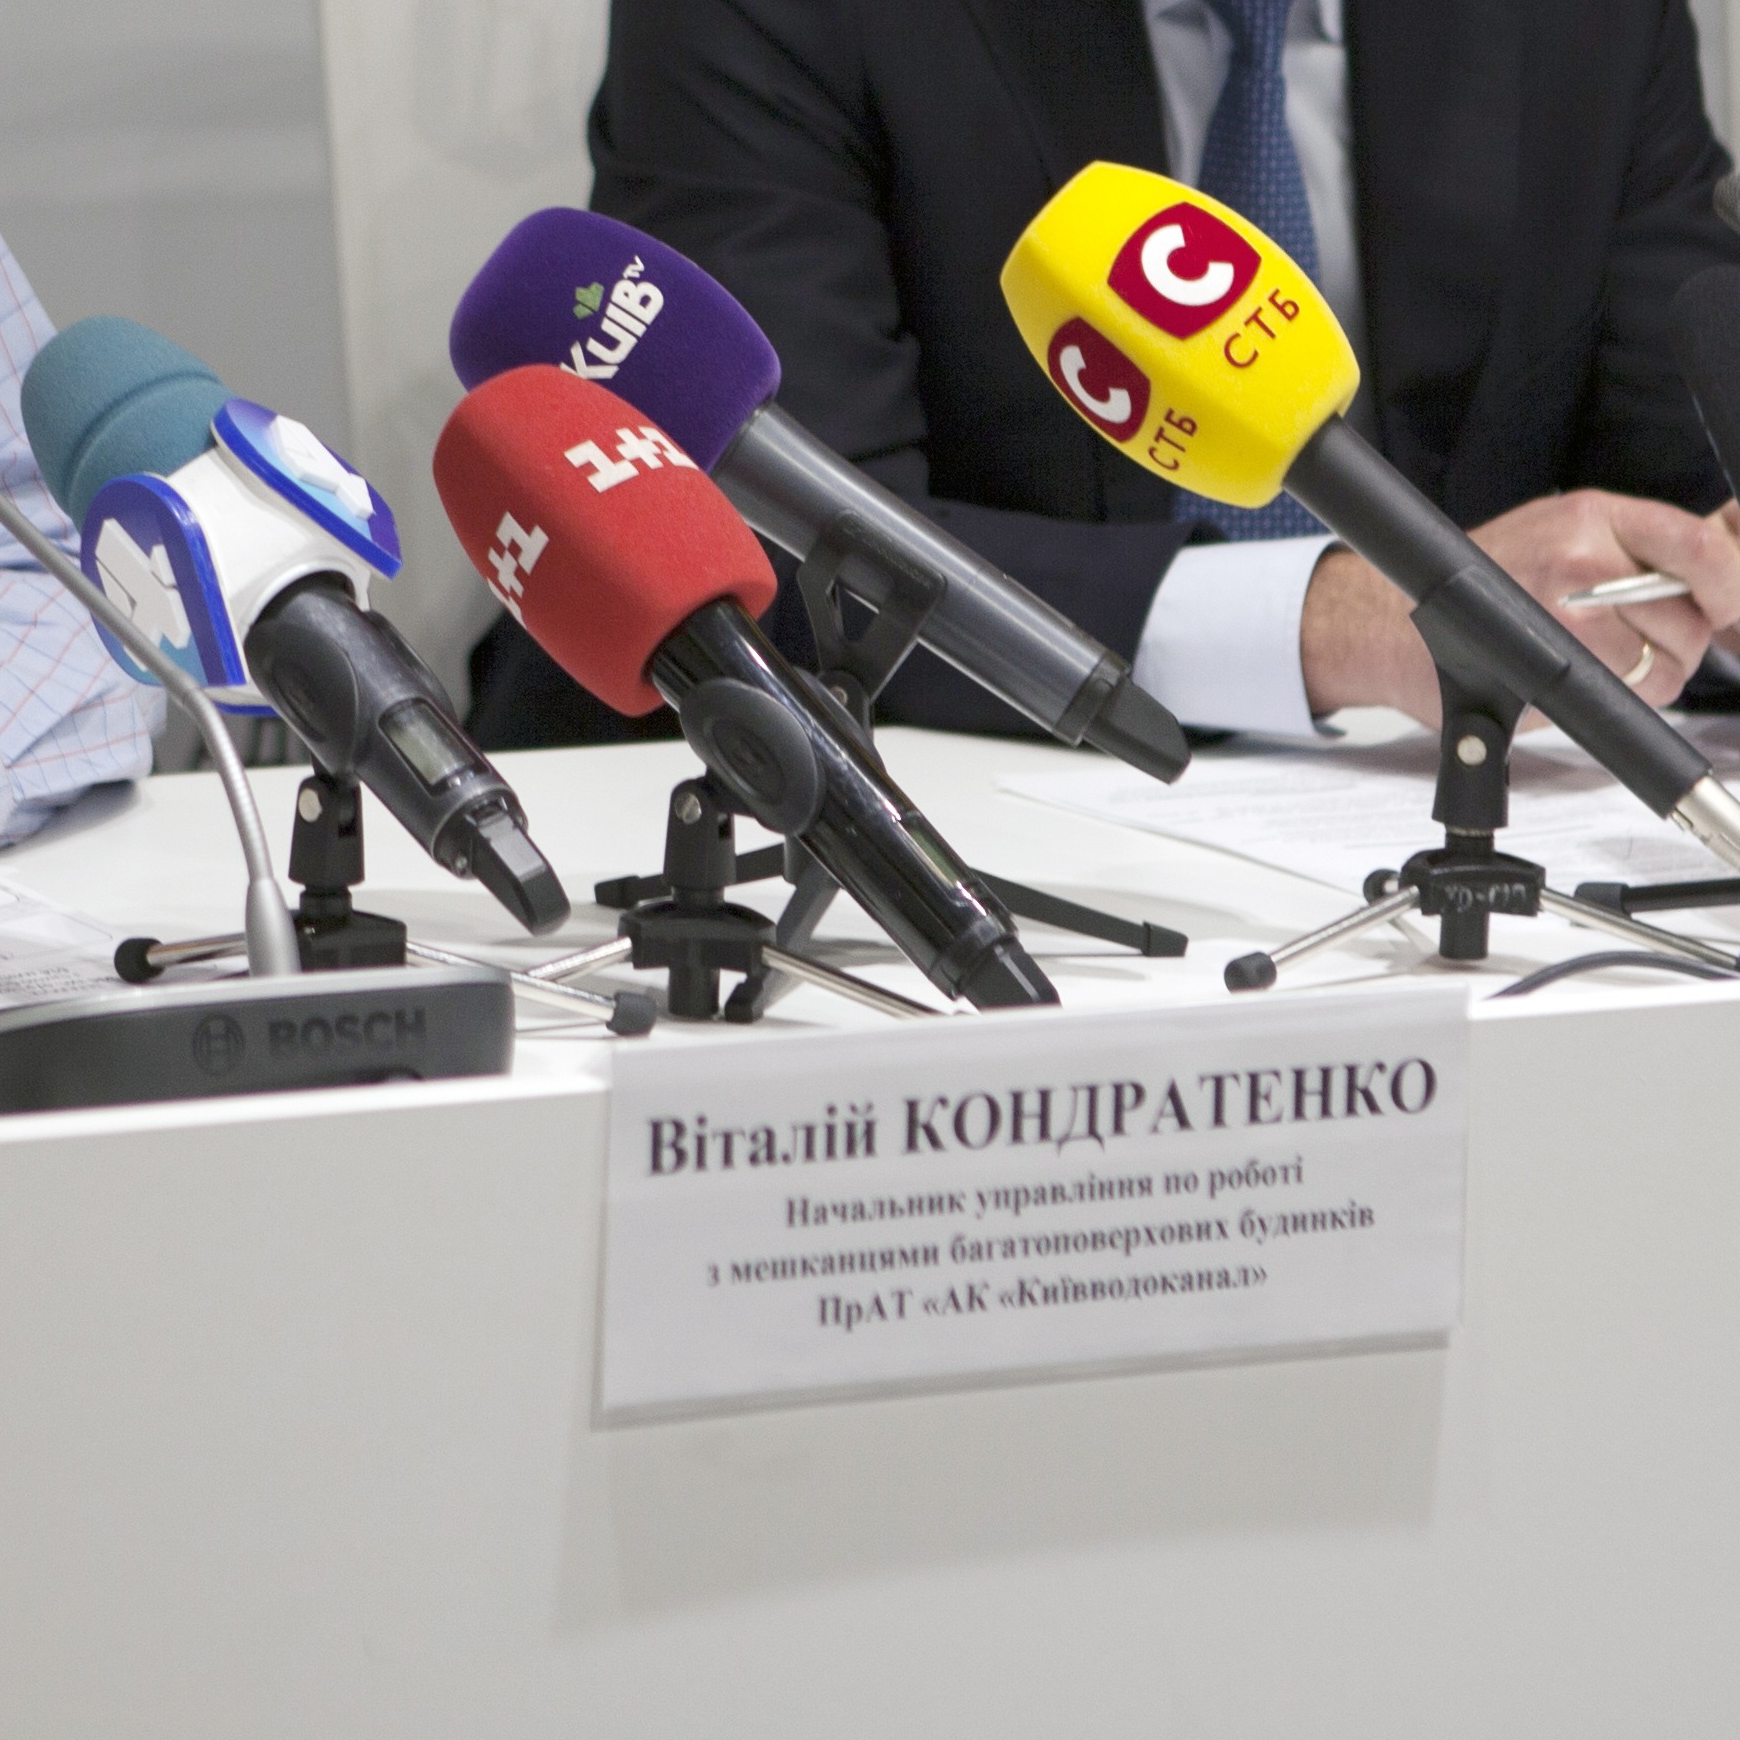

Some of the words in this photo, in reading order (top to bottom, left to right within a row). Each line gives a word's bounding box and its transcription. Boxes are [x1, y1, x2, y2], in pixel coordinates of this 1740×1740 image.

[1224, 289, 1300, 370] СТБ
[1148, 408, 1198, 472] СТБ
[268, 1009, 427, 1056] BOSCH
[647, 1100, 879, 1178] Віталій
[902, 1056, 1440, 1156] КОНДРАТЕНКО
[784, 1190, 967, 1230] Начальник
[973, 1171, 1155, 1219] управління
[1161, 1170, 1201, 1197] по
[1206, 1154, 1305, 1201] роботі
[707, 1263, 721, 1288] з
[729, 1243, 942, 1286] мешканцями
[947, 1217, 1230, 1266] багатоповерхових
[1236, 1199, 1377, 1240] будинків
[816, 1288, 913, 1333] ПрАТ
[920, 1280, 990, 1316] «АК
